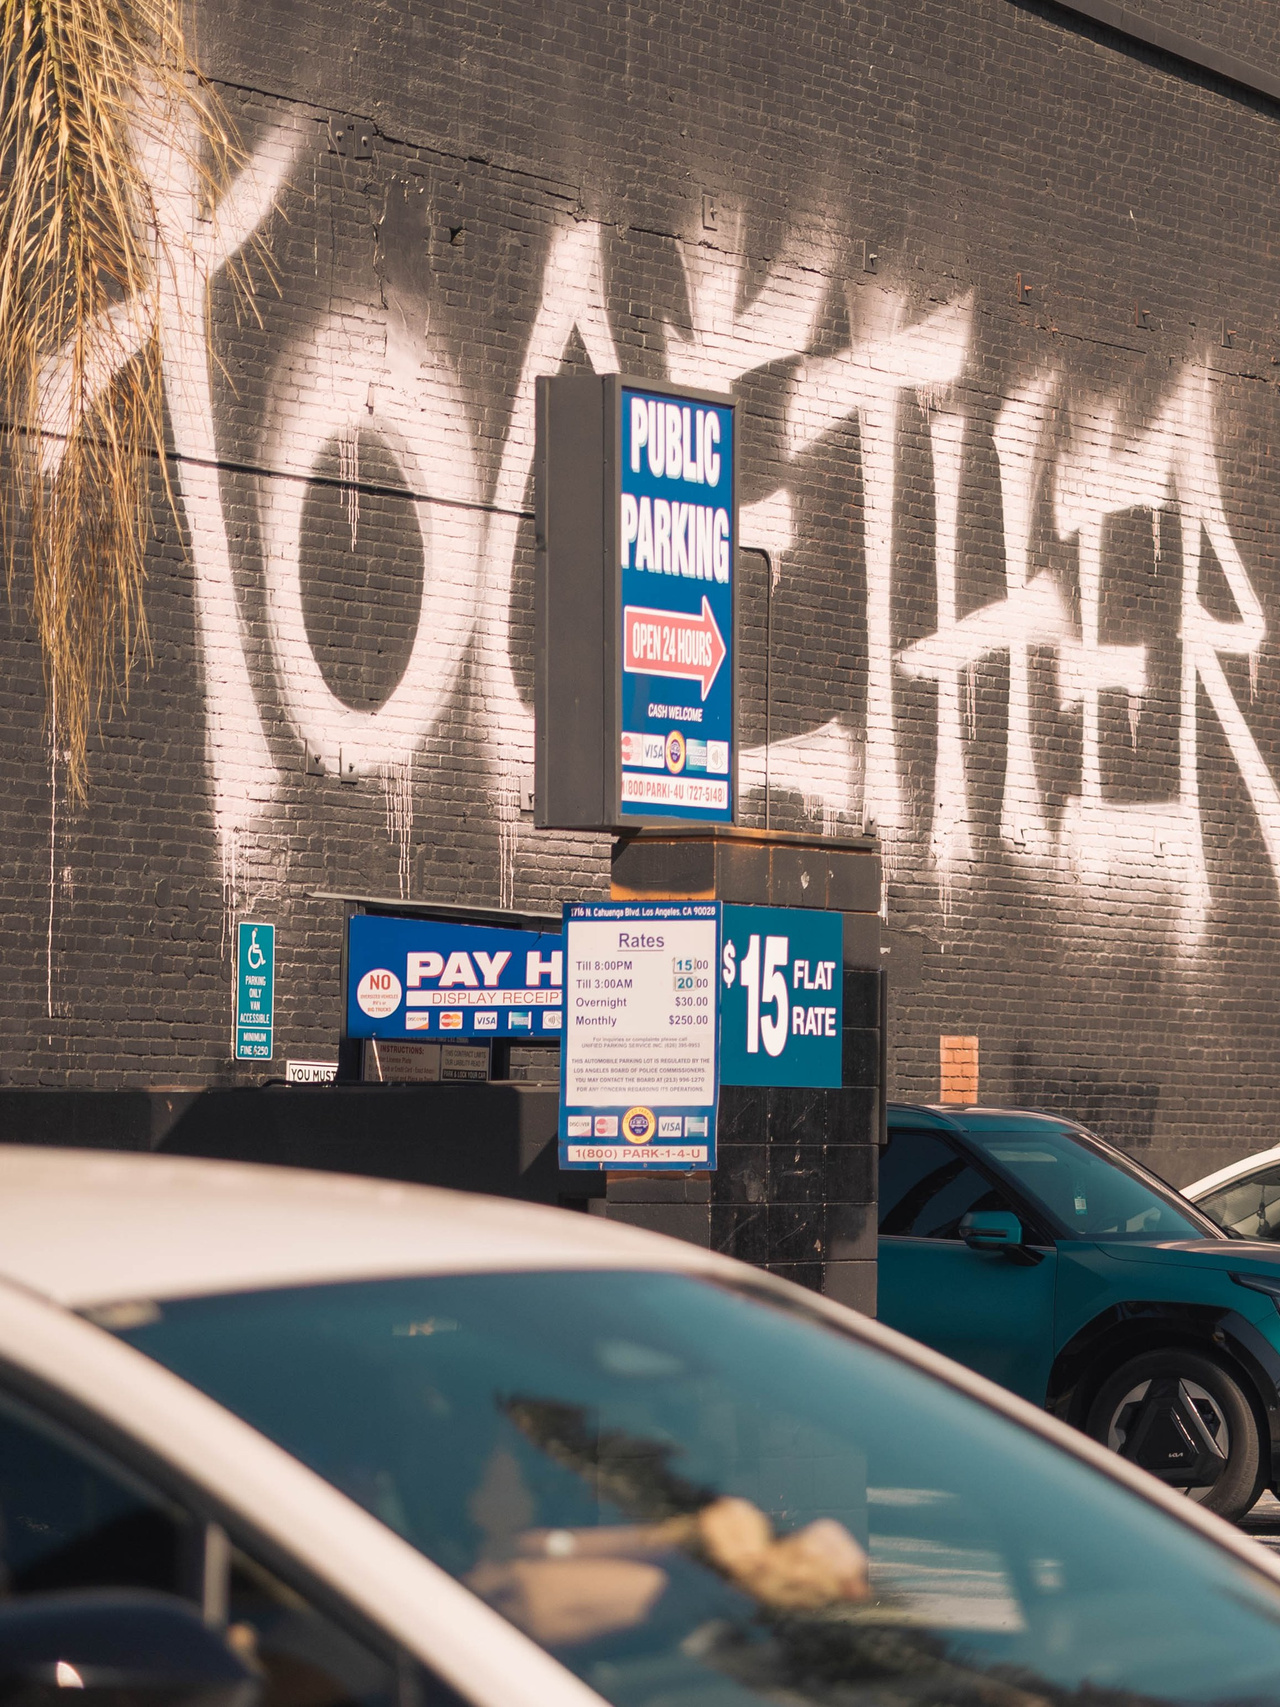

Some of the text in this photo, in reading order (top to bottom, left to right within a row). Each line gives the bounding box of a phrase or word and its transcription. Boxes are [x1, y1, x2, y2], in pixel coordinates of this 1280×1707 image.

[631, 397, 720, 487] PUBLIC
[621, 493, 729, 584] PARKING
[633, 622, 712, 667] OPEN 24 HOURS
[648, 703, 703, 722] CASH WELCOME
[645, 744, 664, 759] VISA
[593, 907, 624, 919] Cahuenga
[625, 907, 641, 917] Blvd.
[642, 907, 654, 917] Los
[683, 906, 692, 916] CA
[693, 906, 716, 916] 90028
[618, 933, 665, 948] Rates
[406, 951, 512, 988] PAY
[576, 961, 592, 971] Till
[594, 961, 633, 971] 8:00PM
[245, 975, 266, 986] PARKING
[793, 959, 836, 990] FLAT
[369, 974, 391, 990] NO
[576, 979, 592, 989] Till
[594, 979, 633, 989] 3:00AM
[249, 989, 262, 999] ONLY
[432, 991, 496, 1004] DISPLAY
[250, 1001, 260, 1011] VAN
[576, 996, 708, 1009] Overnight $30.00
[240, 1013, 269, 1024] ACCESSIBLE
[477, 1016, 496, 1025] VISA
[576, 1015, 708, 1027] Monthly $250.00
[792, 1006, 836, 1036] RATE
[243, 1032, 266, 1042] MINIMUM
[240, 1045, 268, 1056] FINE $250
[380, 1044, 425, 1055] INSTRUCTIONS:
[291, 1068, 310, 1081] YOU
[457, 1070, 467, 1078] LOCK
[661, 1122, 681, 1132] VISA
[576, 1148, 700, 1160] 1(800) PARK-1-4-U
